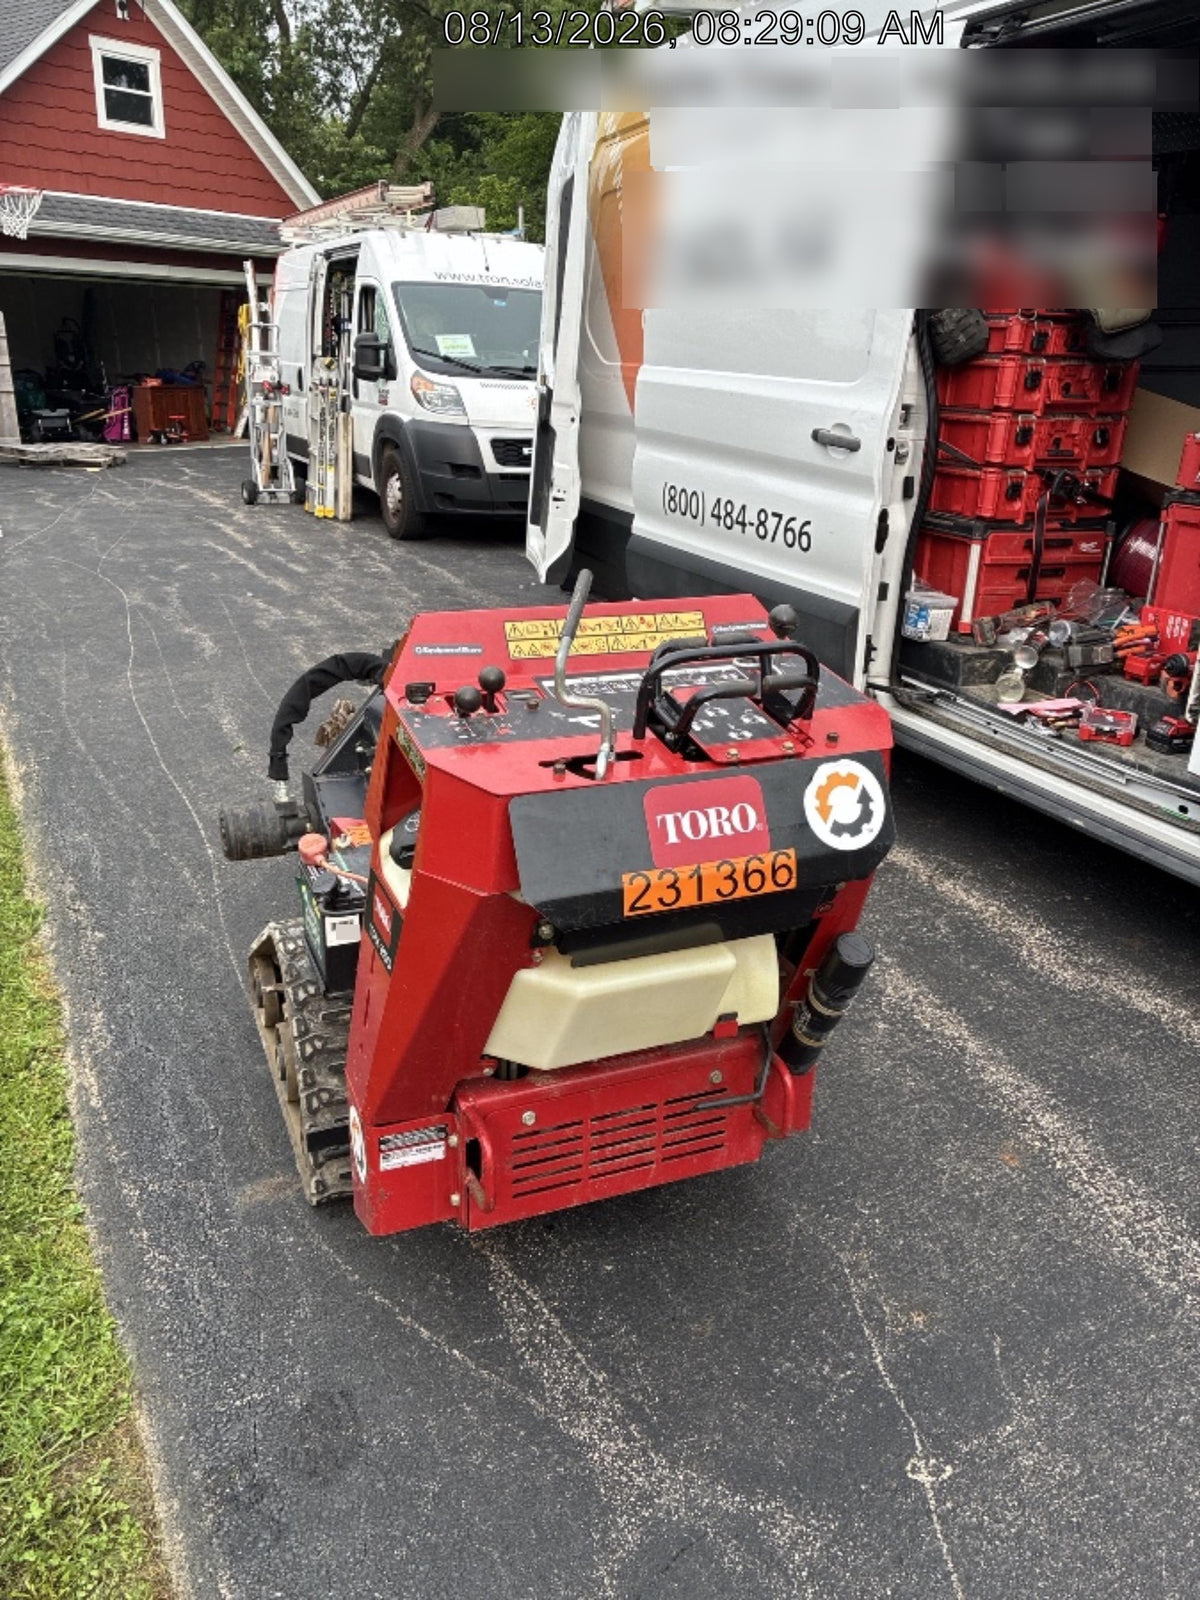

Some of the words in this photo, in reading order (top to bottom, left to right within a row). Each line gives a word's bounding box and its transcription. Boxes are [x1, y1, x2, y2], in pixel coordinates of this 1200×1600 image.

[662, 482, 705, 527] (800)
[710, 497, 812, 552] 484-8766
[656, 802, 758, 846] TORO
[627, 850, 794, 913] 231366
